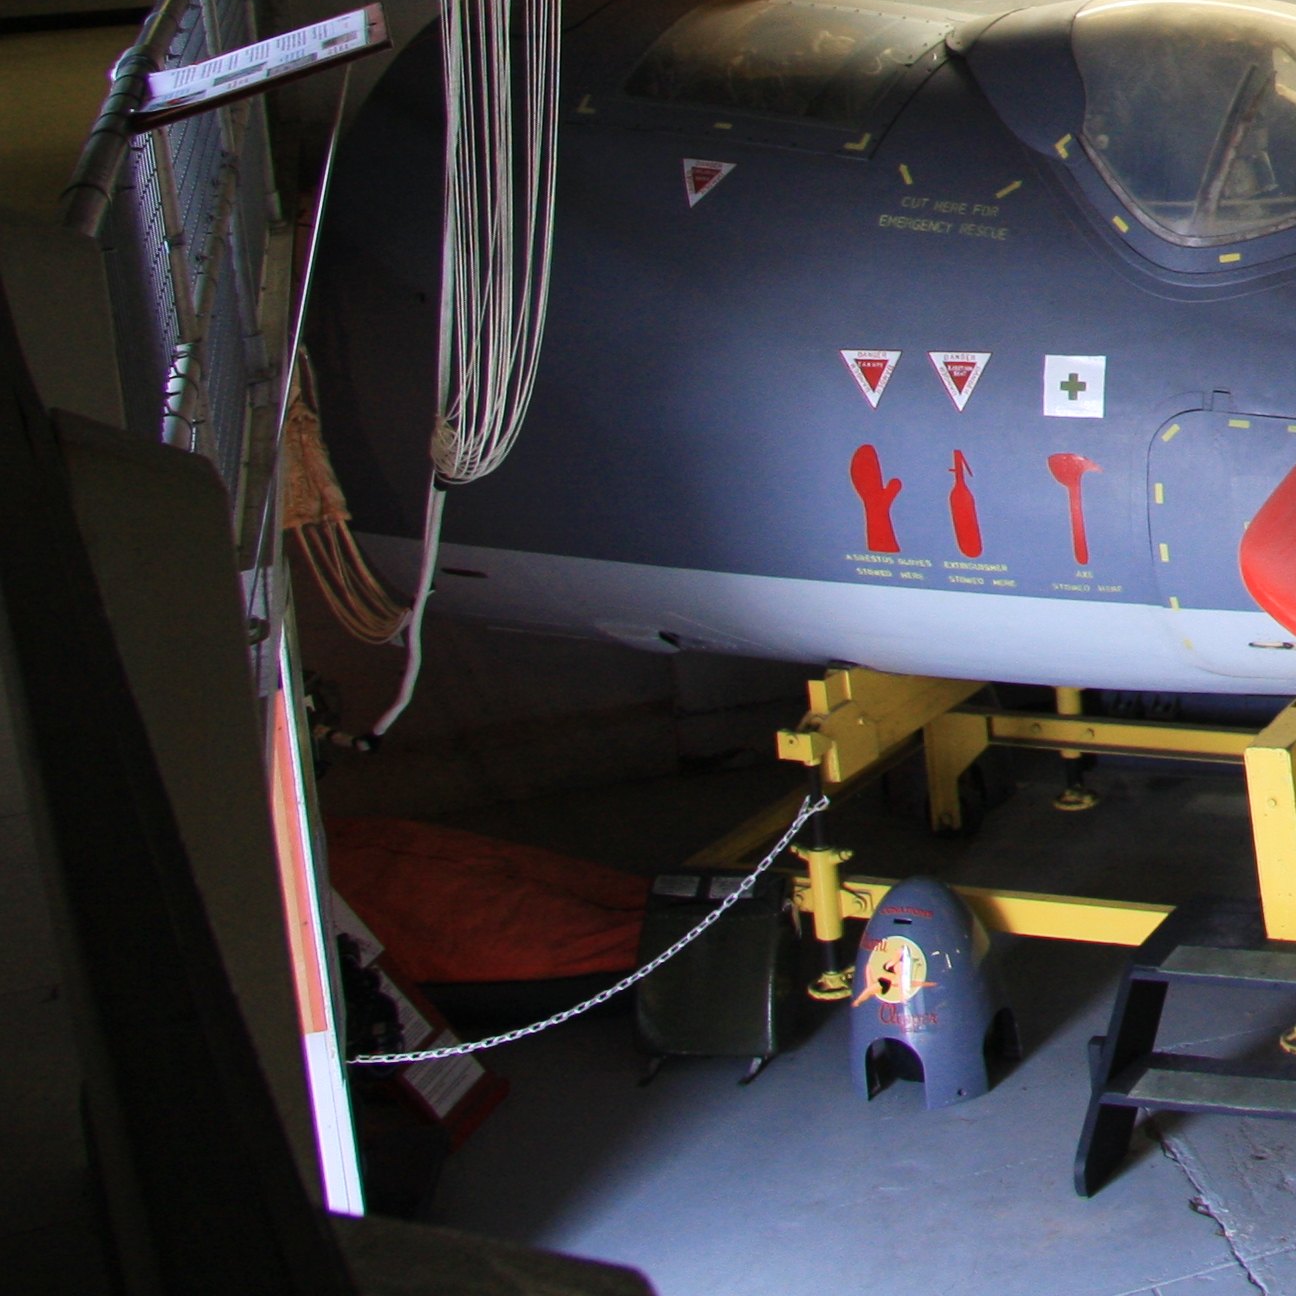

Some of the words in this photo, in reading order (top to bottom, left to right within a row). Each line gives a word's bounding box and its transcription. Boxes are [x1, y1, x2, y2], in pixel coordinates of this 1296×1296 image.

[901, 196, 929, 209] CUT
[933, 200, 967, 215] HERE
[972, 203, 999, 217] FOR
[879, 214, 953, 233] EMERGENCY
[959, 223, 1008, 241] RESCUE
[845, 554, 895, 565] ASBESTOS
[897, 558, 933, 568] GLOVES
[943, 560, 1009, 572] EXTINGUISHER
[856, 567, 893, 578] STOWED
[900, 571, 924, 581] HERE
[949, 575, 985, 585] STOWED
[992, 578, 1017, 588] HERE
[1052, 582, 1091, 592] STOWED
[1097, 584, 1122, 592] HERE
